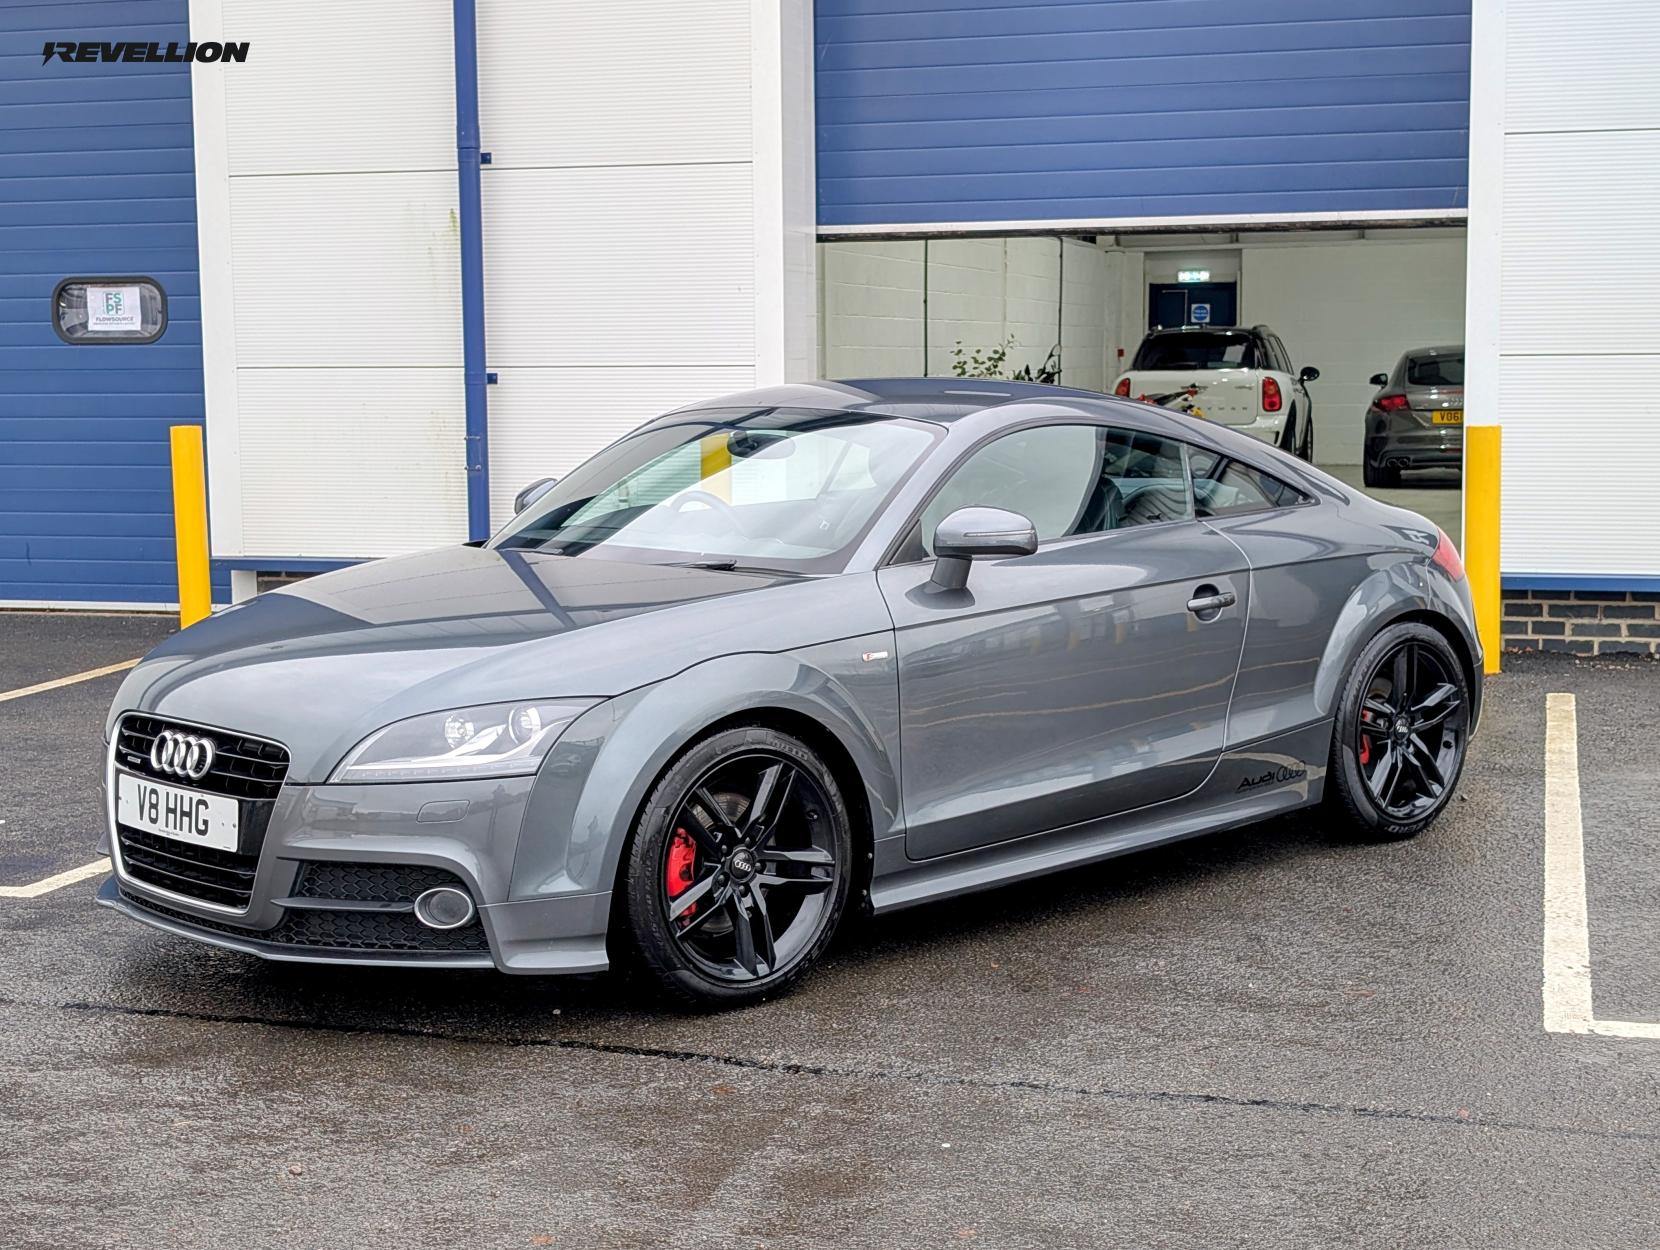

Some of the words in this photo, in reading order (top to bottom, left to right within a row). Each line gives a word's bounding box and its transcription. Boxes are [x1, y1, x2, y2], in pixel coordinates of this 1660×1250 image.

[105, 292, 122, 304] FS
[106, 303, 122, 314] PF
[137, 783, 159, 825] V8
[165, 791, 209, 836] HHG
